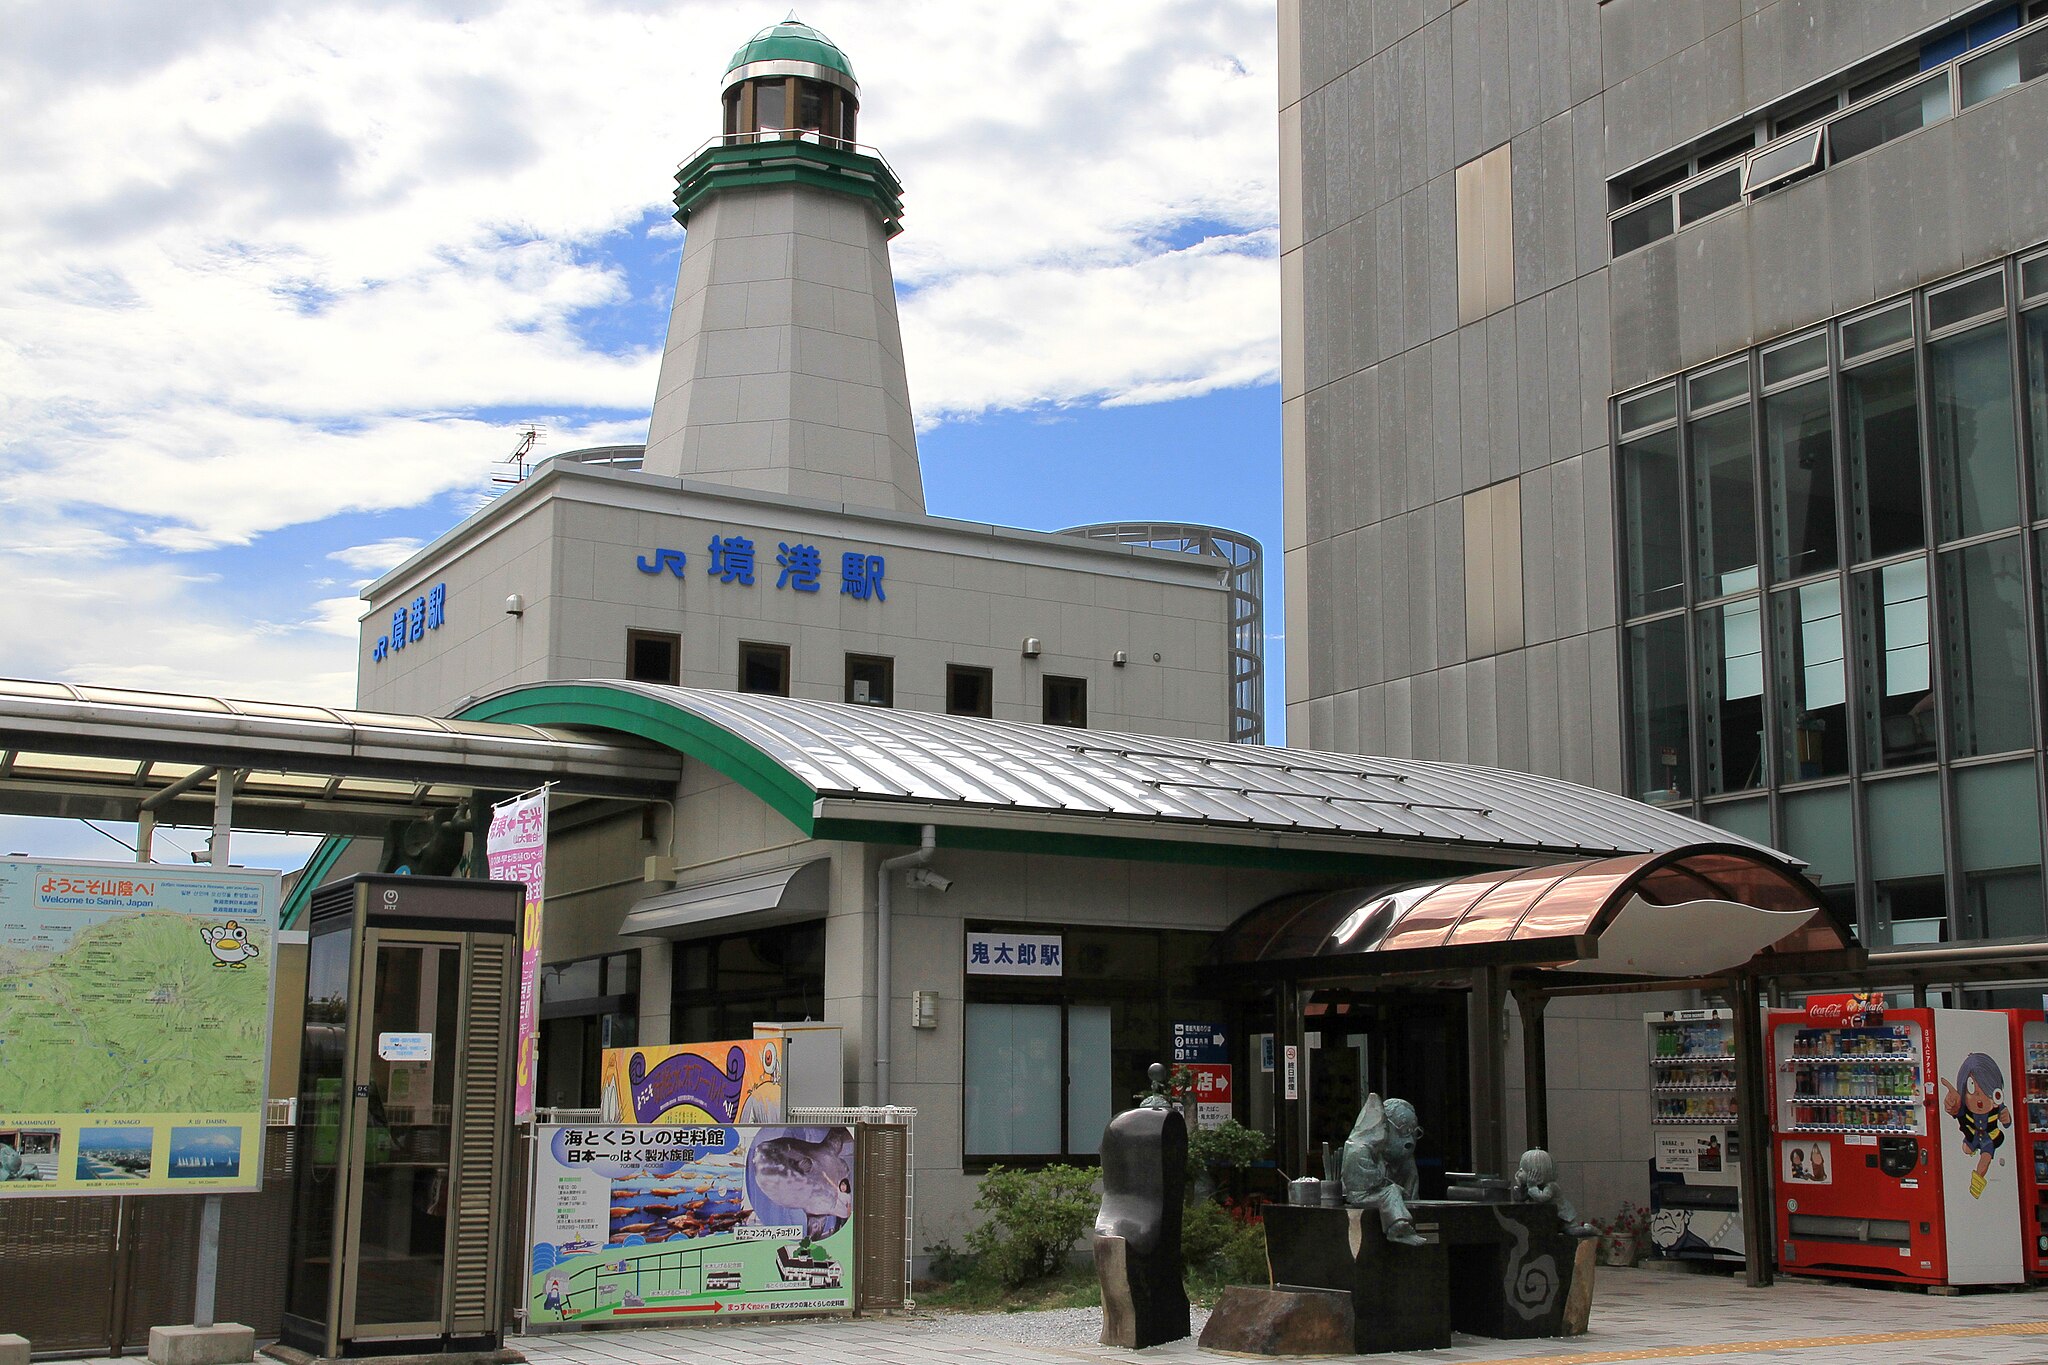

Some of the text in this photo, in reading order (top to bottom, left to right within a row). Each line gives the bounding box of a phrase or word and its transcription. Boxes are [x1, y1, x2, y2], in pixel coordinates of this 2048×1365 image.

[637, 535, 886, 602] JR 境港駅
[373, 582, 446, 662] JR 境港駅
[41, 877, 155, 897] ようこそ山陰へ!
[41, 894, 153, 908] Welcome to Sanin, Japan
[971, 942, 1060, 966] 鬼太郎駅
[1810, 1003, 1842, 1017] Coca-Cola
[564, 1129, 724, 1147] 海とくらしの史料館
[567, 1149, 695, 1163] 日本一のはく製水族館
